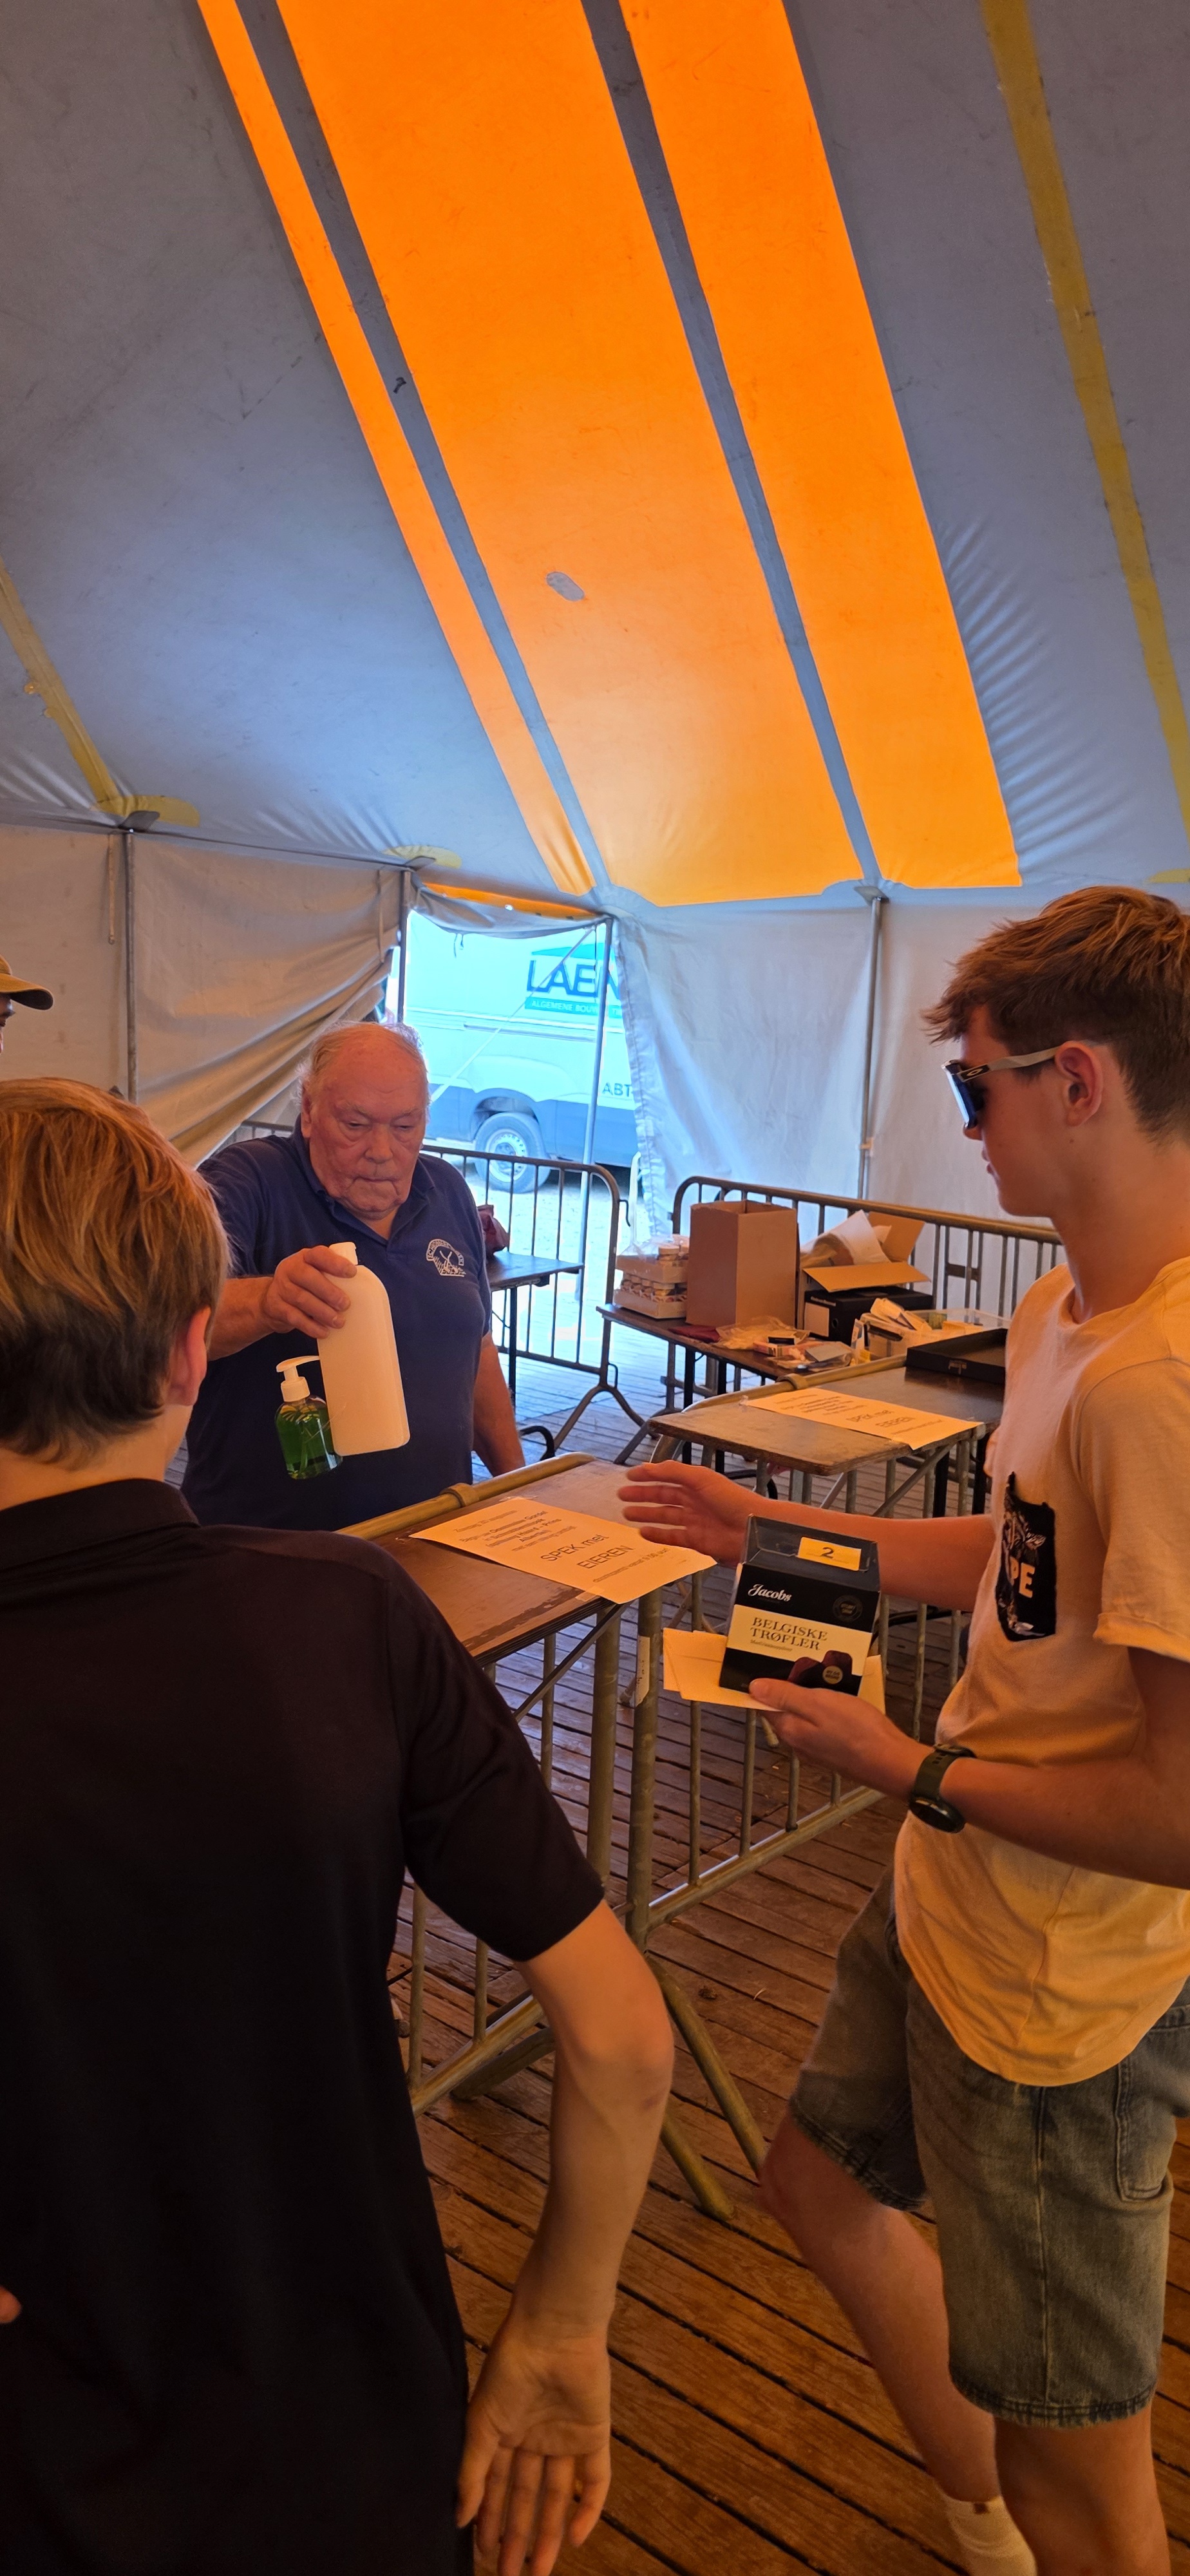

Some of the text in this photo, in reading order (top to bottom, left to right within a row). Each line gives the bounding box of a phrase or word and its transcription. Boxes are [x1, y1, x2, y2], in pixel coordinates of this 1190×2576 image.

[540, 1544, 585, 1562] SPEK
[581, 1534, 610, 1546] met
[576, 1544, 634, 1569] EIEREN
[820, 1547, 835, 1559] 2
[748, 1584, 792, 1602] Jacobs
[750, 1627, 821, 1651] TRØFLER
[752, 1617, 828, 1641] BELGISKE
